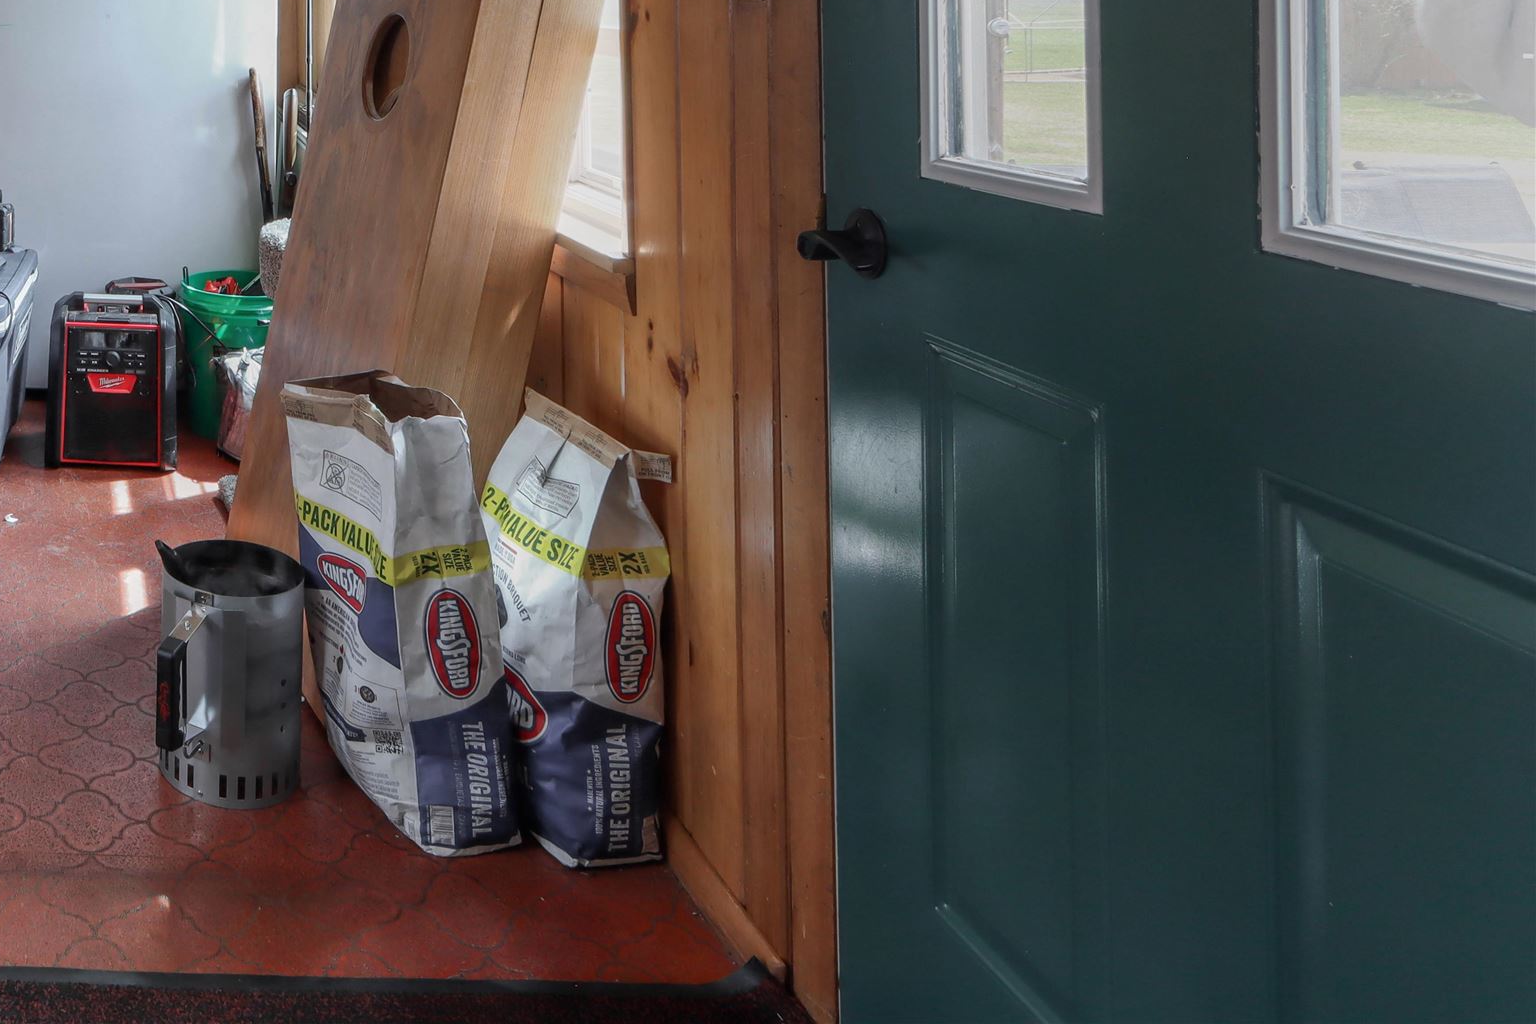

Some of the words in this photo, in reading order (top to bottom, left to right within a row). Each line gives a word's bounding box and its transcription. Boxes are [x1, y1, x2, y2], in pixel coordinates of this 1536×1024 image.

[443, 552, 455, 571] SIZE
[451, 547, 465, 573] VALUE
[546, 537, 580, 570] SIZE
[593, 552, 610, 577] VALUE
[605, 556, 618, 573] SIZE
[619, 551, 643, 575] 2X
[507, 578, 531, 623] BRIQUET
[435, 599, 472, 690] KINGSFORD
[615, 601, 648, 694] KINGSFORD
[462, 721, 487, 752] THE
[591, 744, 603, 789] INGREDIENTS
[605, 724, 632, 815] ORIGINAL
[466, 753, 493, 838] ORIGINAL
[595, 790, 604, 817] NATURAL
[608, 818, 630, 852] THE
